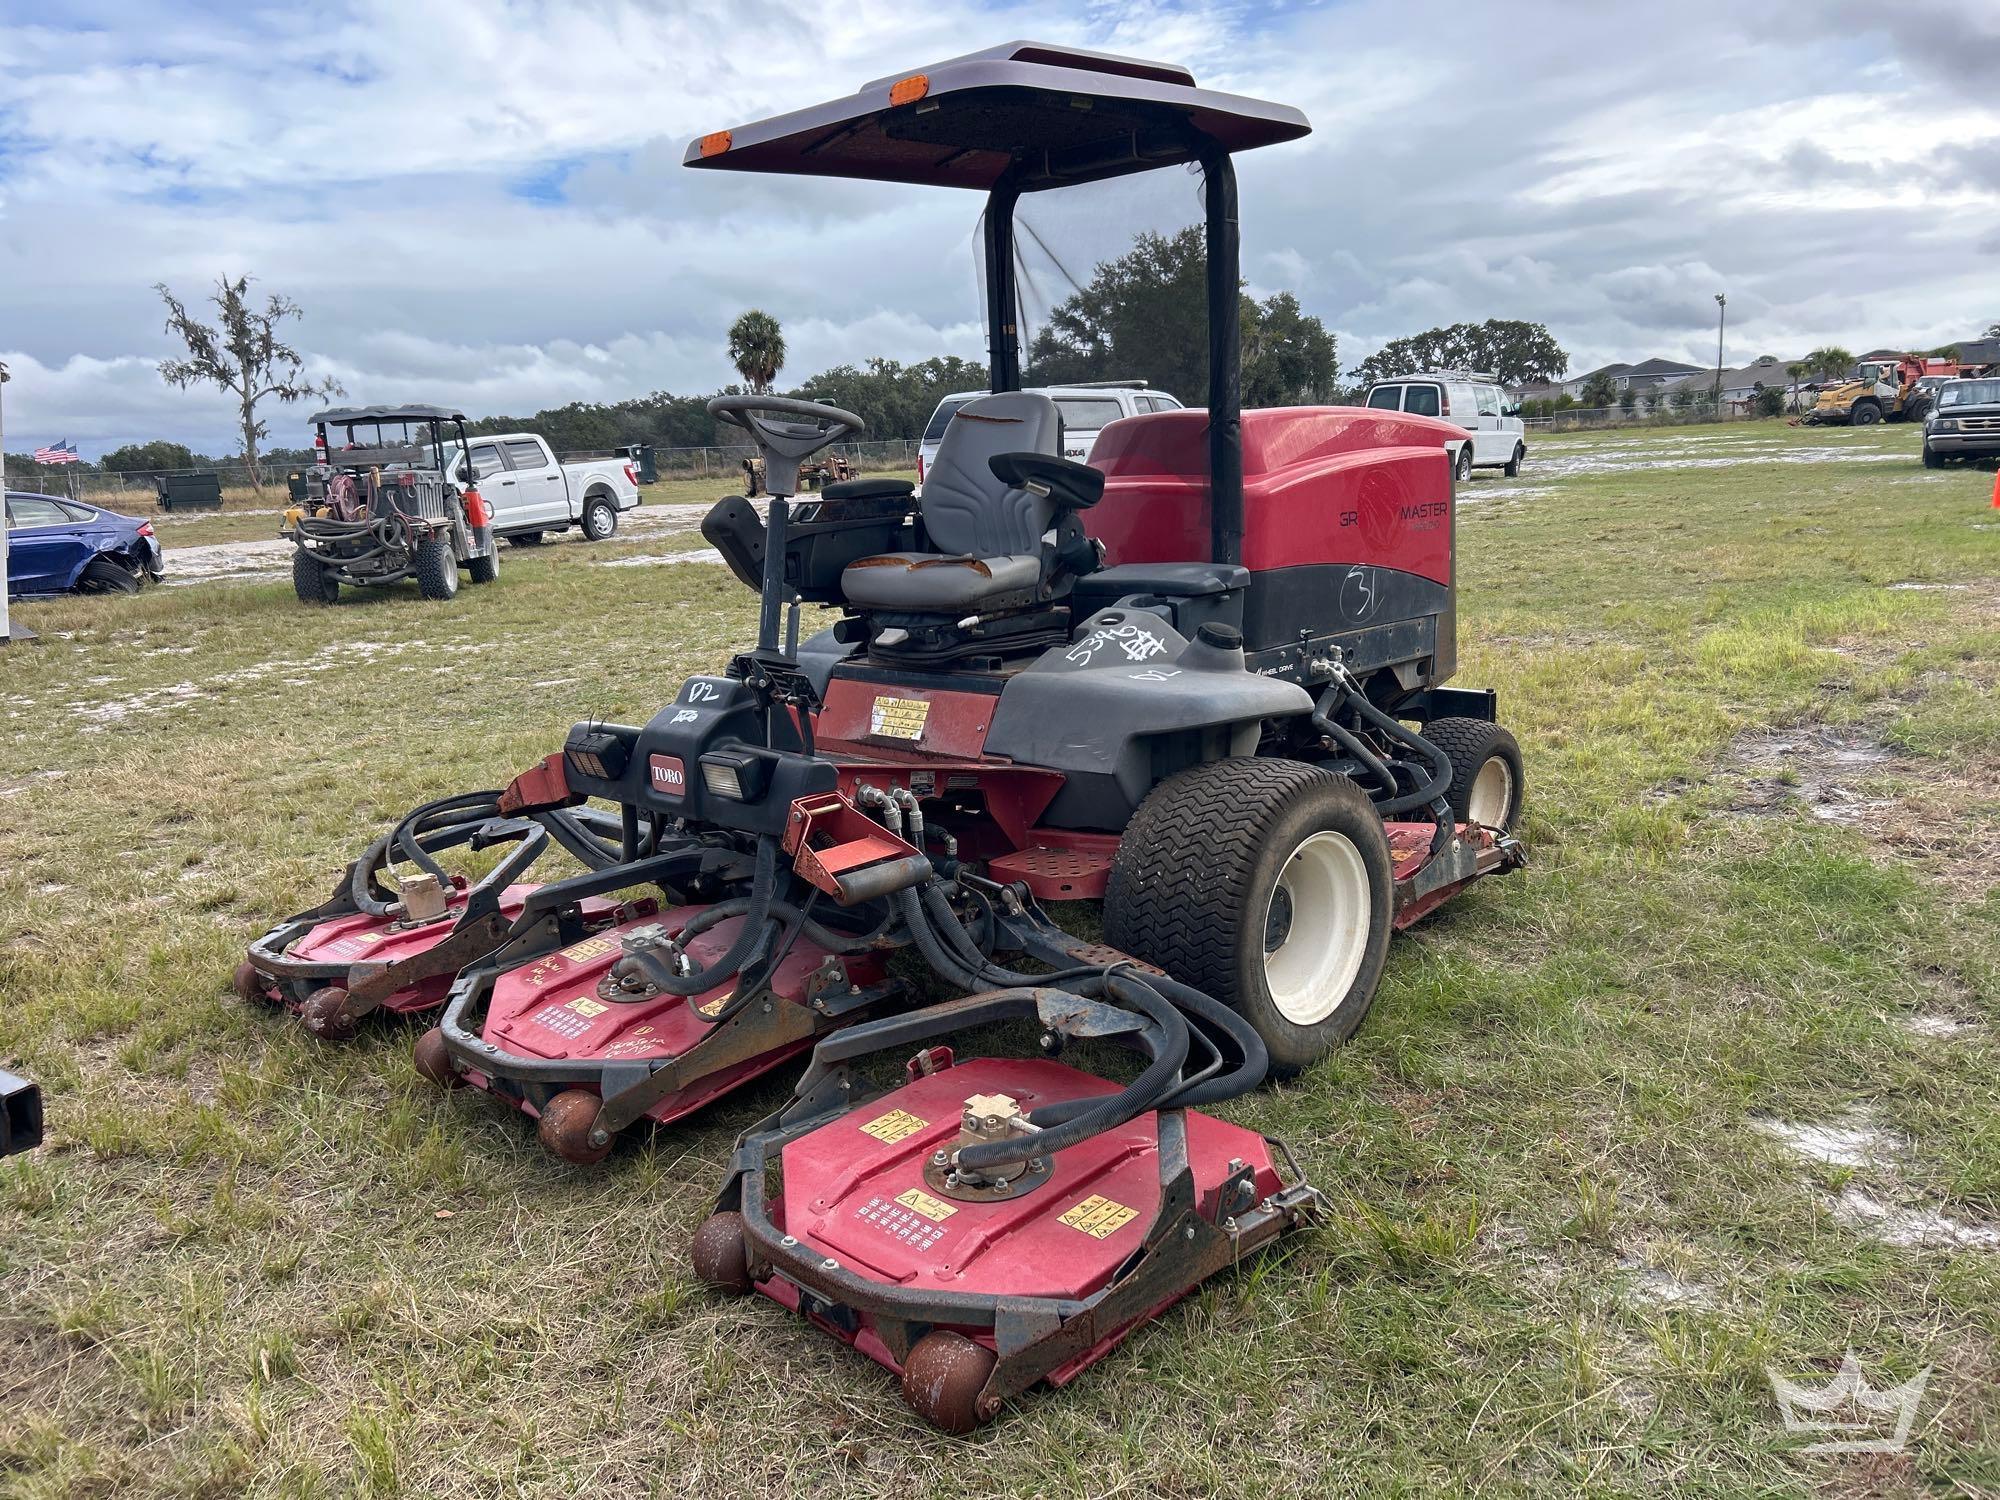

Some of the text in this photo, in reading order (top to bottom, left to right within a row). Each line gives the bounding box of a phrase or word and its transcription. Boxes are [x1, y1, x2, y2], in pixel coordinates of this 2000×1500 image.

[1400, 502, 1447, 520] MASTER
[1066, 625, 1138, 667] 5346
[1279, 664, 1294, 673] DRIVE
[653, 766, 683, 785] TORO
